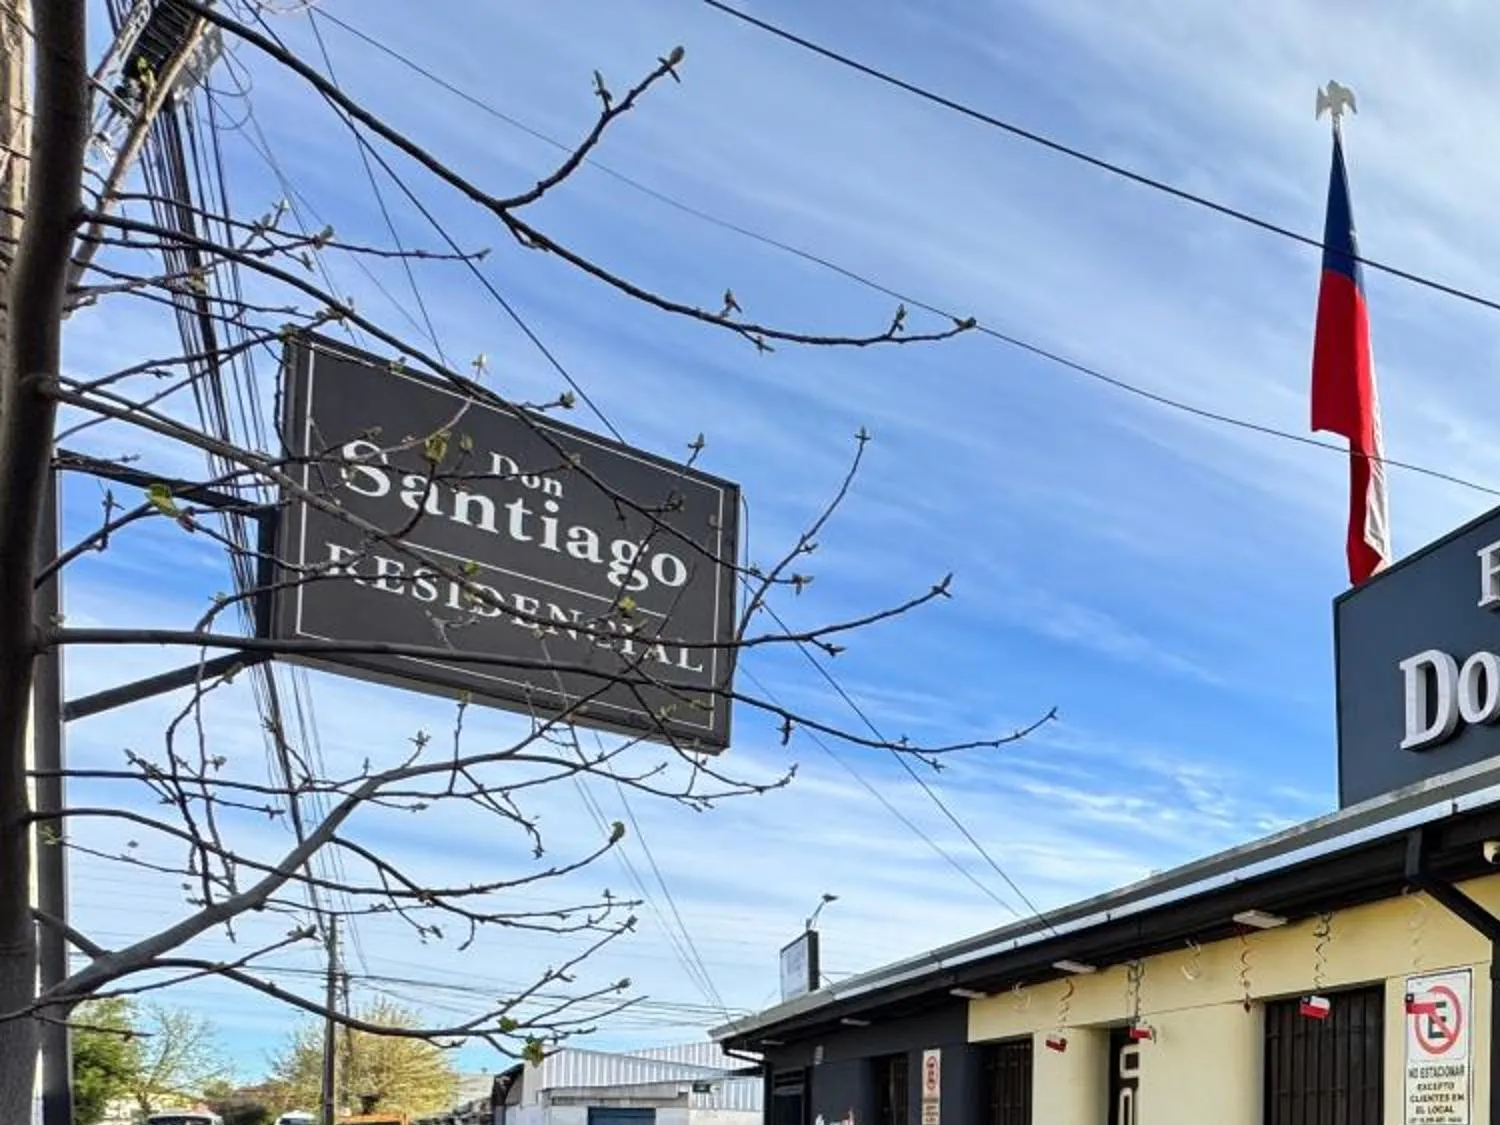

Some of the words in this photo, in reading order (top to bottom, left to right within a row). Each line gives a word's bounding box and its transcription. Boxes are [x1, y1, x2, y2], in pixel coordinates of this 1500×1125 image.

[489, 452, 563, 499] Don
[341, 439, 688, 593] Santiago
[1417, 1082, 1455, 1091] EXCEPTO
[1409, 1094, 1450, 1103] CLIENTES
[1428, 1104, 1455, 1114] LOCAL
